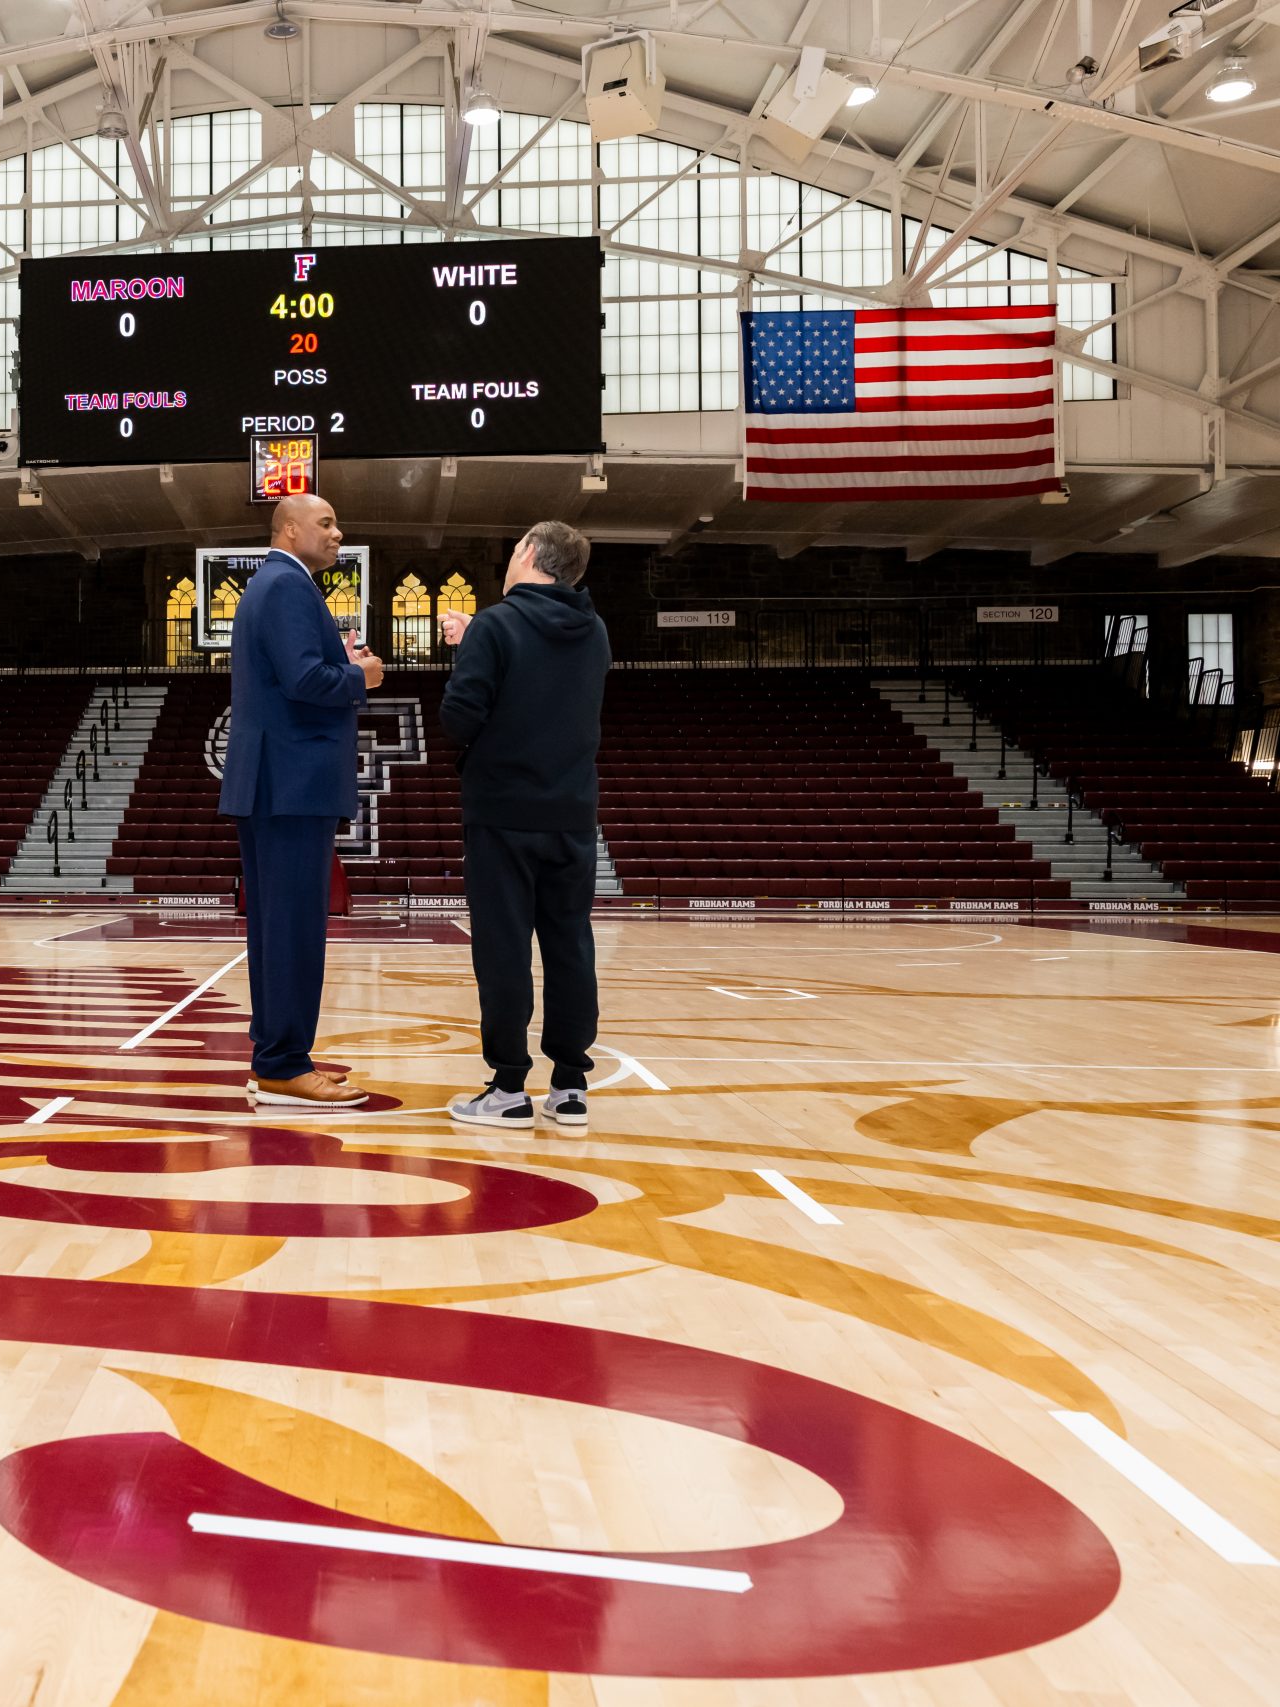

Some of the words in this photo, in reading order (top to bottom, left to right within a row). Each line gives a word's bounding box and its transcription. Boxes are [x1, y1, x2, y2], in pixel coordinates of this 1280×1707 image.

[294, 254, 316, 282] F
[432, 264, 517, 288] WHITE
[71, 276, 184, 302] MAROON
[270, 293, 334, 319] 4:00
[469, 300, 486, 325] 0
[119, 312, 136, 337] 0
[290, 333, 318, 353] 20
[274, 369, 327, 385] POSS
[411, 383, 467, 400] TEAM
[472, 381, 539, 399] FOULS
[64, 393, 118, 411] TEAM
[122, 391, 187, 409] FOULS
[120, 417, 133, 438] 0
[242, 415, 315, 432] PERIOD
[330, 412, 344, 432] 2
[471, 408, 485, 428] 0
[269, 441, 311, 459] 4:00
[264, 460, 305, 493] 20
[662, 615, 699, 623] SECTION
[706, 613, 730, 624] 119
[983, 610, 1020, 618] SECTION
[1030, 608, 1053, 619] 120
[689, 900, 729, 908] FORDHAM
[731, 900, 756, 908] RAMS
[865, 901, 890, 909] RAMS
[1089, 902, 1131, 910] FORDHAM
[1133, 902, 1159, 910] RAMS
